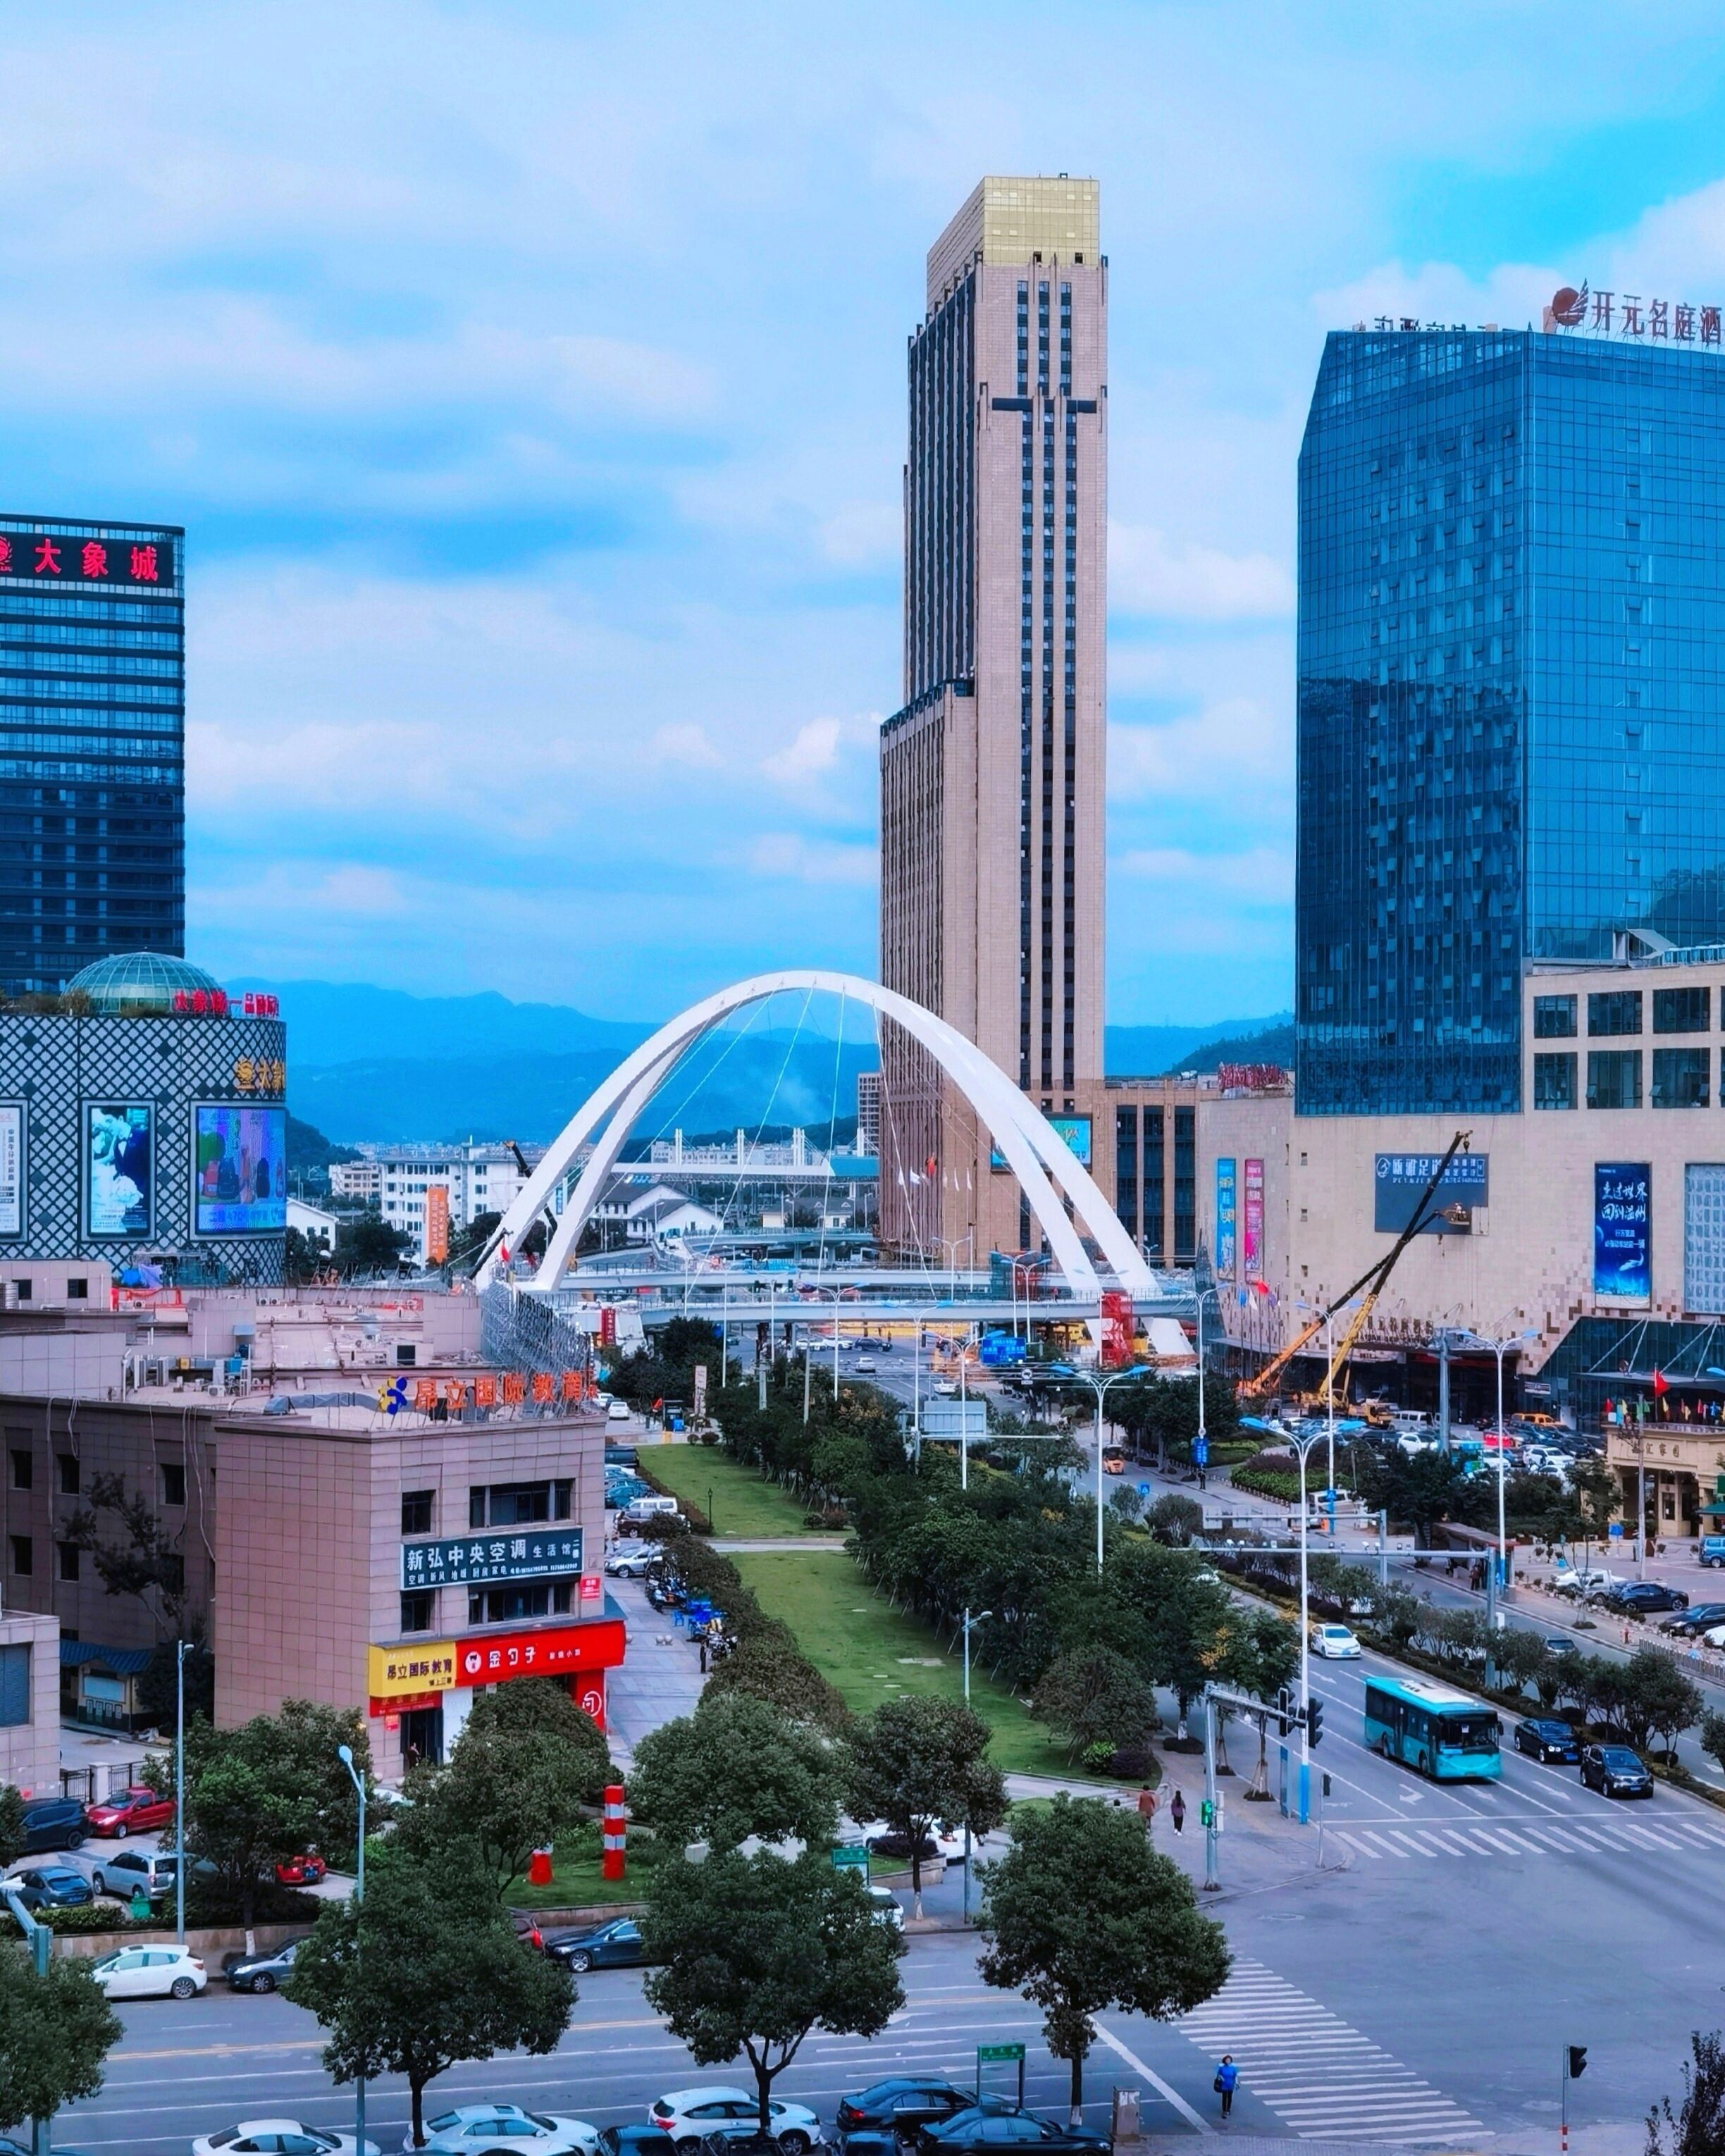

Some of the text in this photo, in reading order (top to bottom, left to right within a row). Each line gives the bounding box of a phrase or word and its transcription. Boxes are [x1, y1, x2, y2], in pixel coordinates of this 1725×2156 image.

[1591, 291, 1722, 345] 开元名庭酒
[35, 538, 158, 581] 大象城
[1602, 1203, 1646, 1222] 回到温州
[414, 1370, 581, 1411] 昂立国际教育
[407, 1539, 526, 1571] 新弘中央空调
[533, 1542, 571, 1559] 生活馆
[409, 1575, 425, 1585] 空调
[431, 1571, 445, 1582] 新风
[388, 1658, 452, 1680] 昂立国际教育
